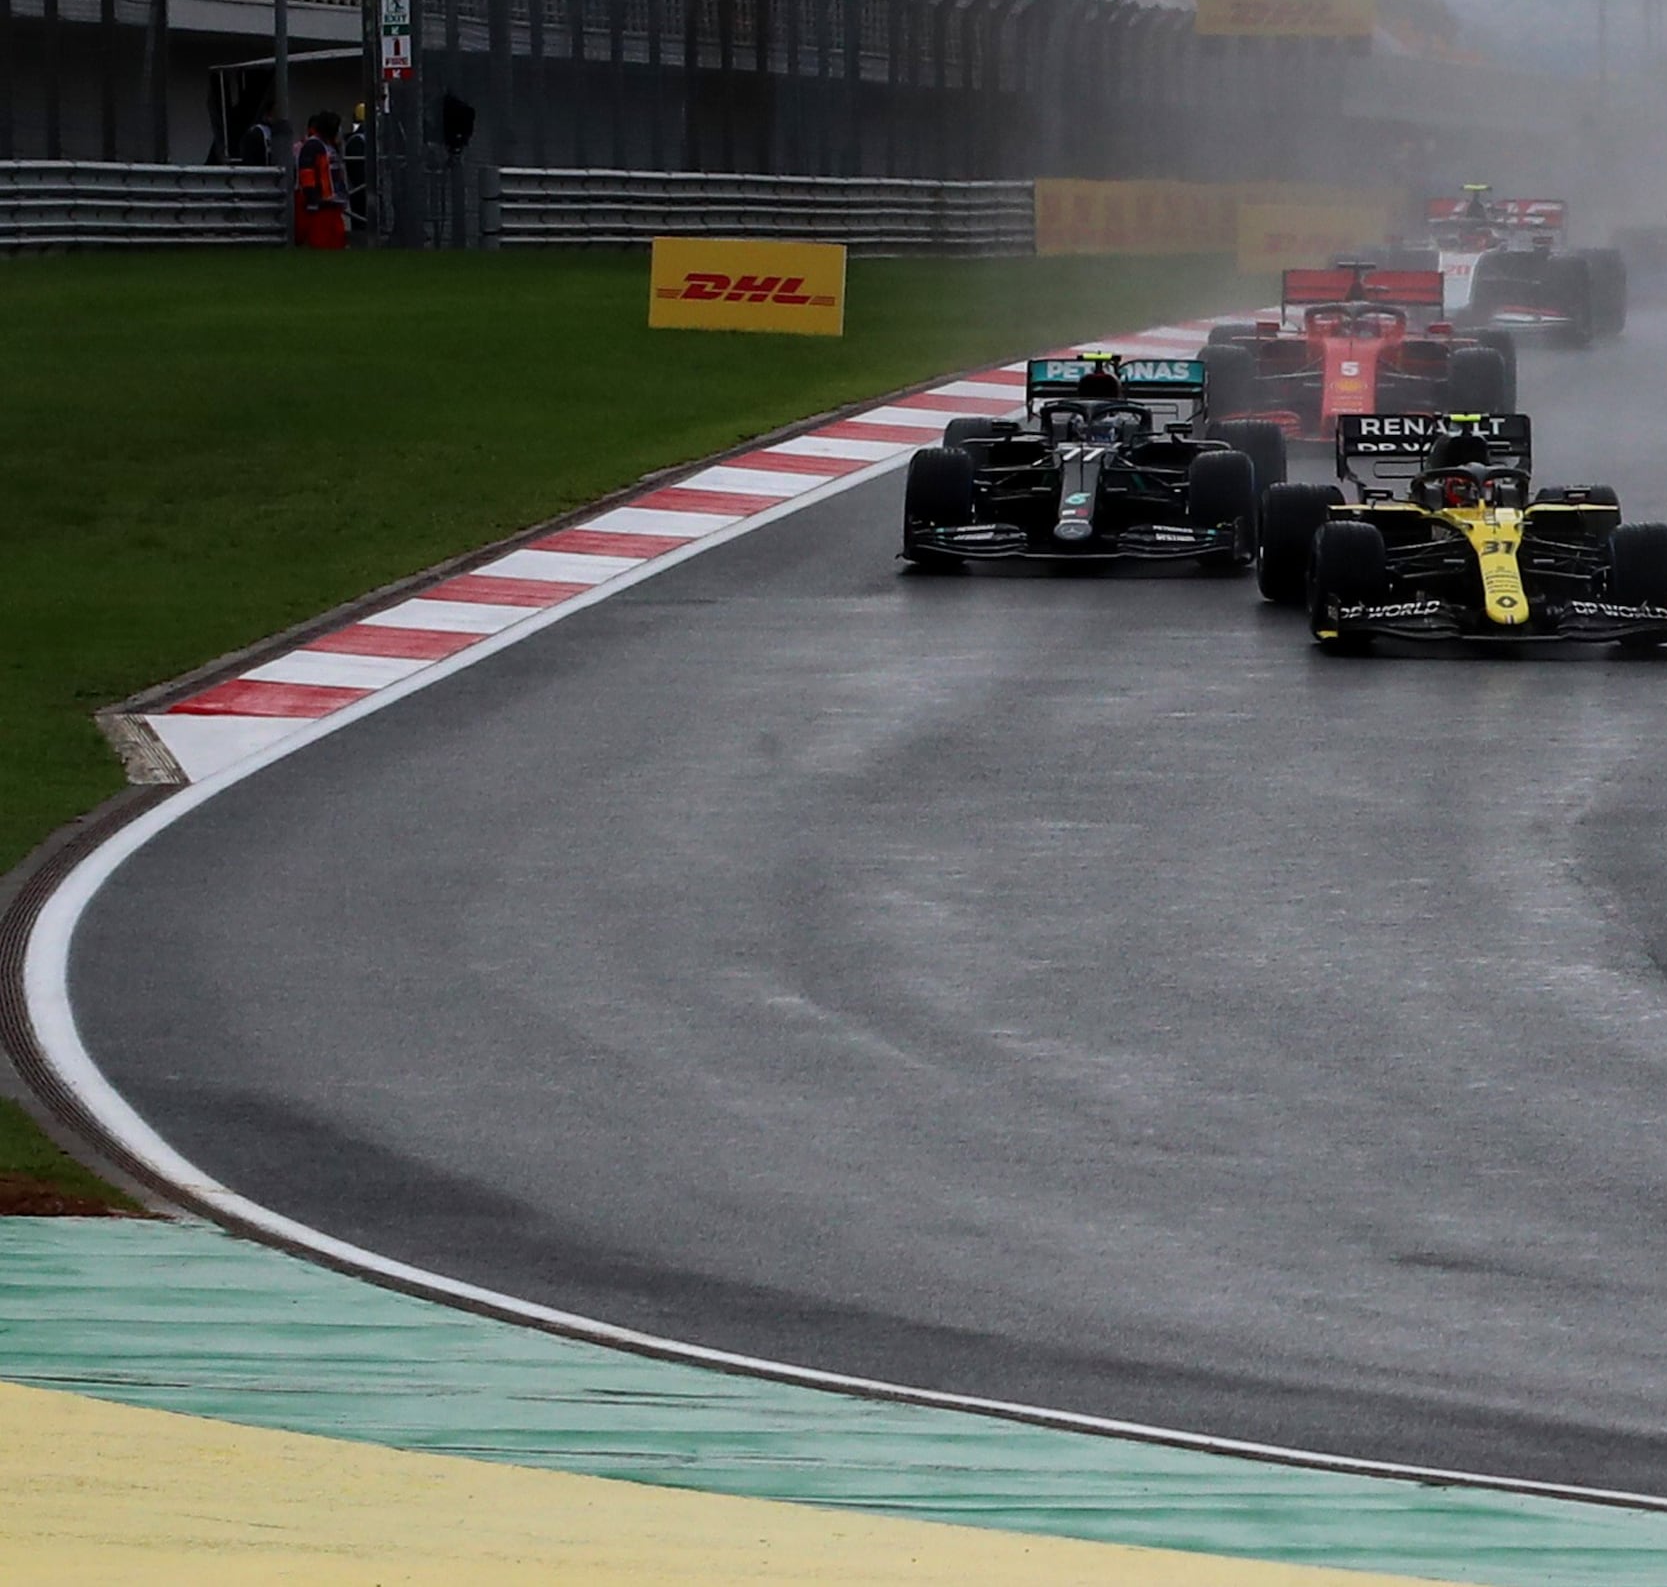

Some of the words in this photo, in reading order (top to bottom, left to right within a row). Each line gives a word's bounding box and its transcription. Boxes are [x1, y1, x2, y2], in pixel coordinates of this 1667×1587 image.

[384, 14, 408, 23] EXIT
[680, 273, 815, 305] DHL
[1340, 361, 1360, 376] 5
[1062, 447, 1105, 461] 77
[1481, 541, 1514, 555] 31
